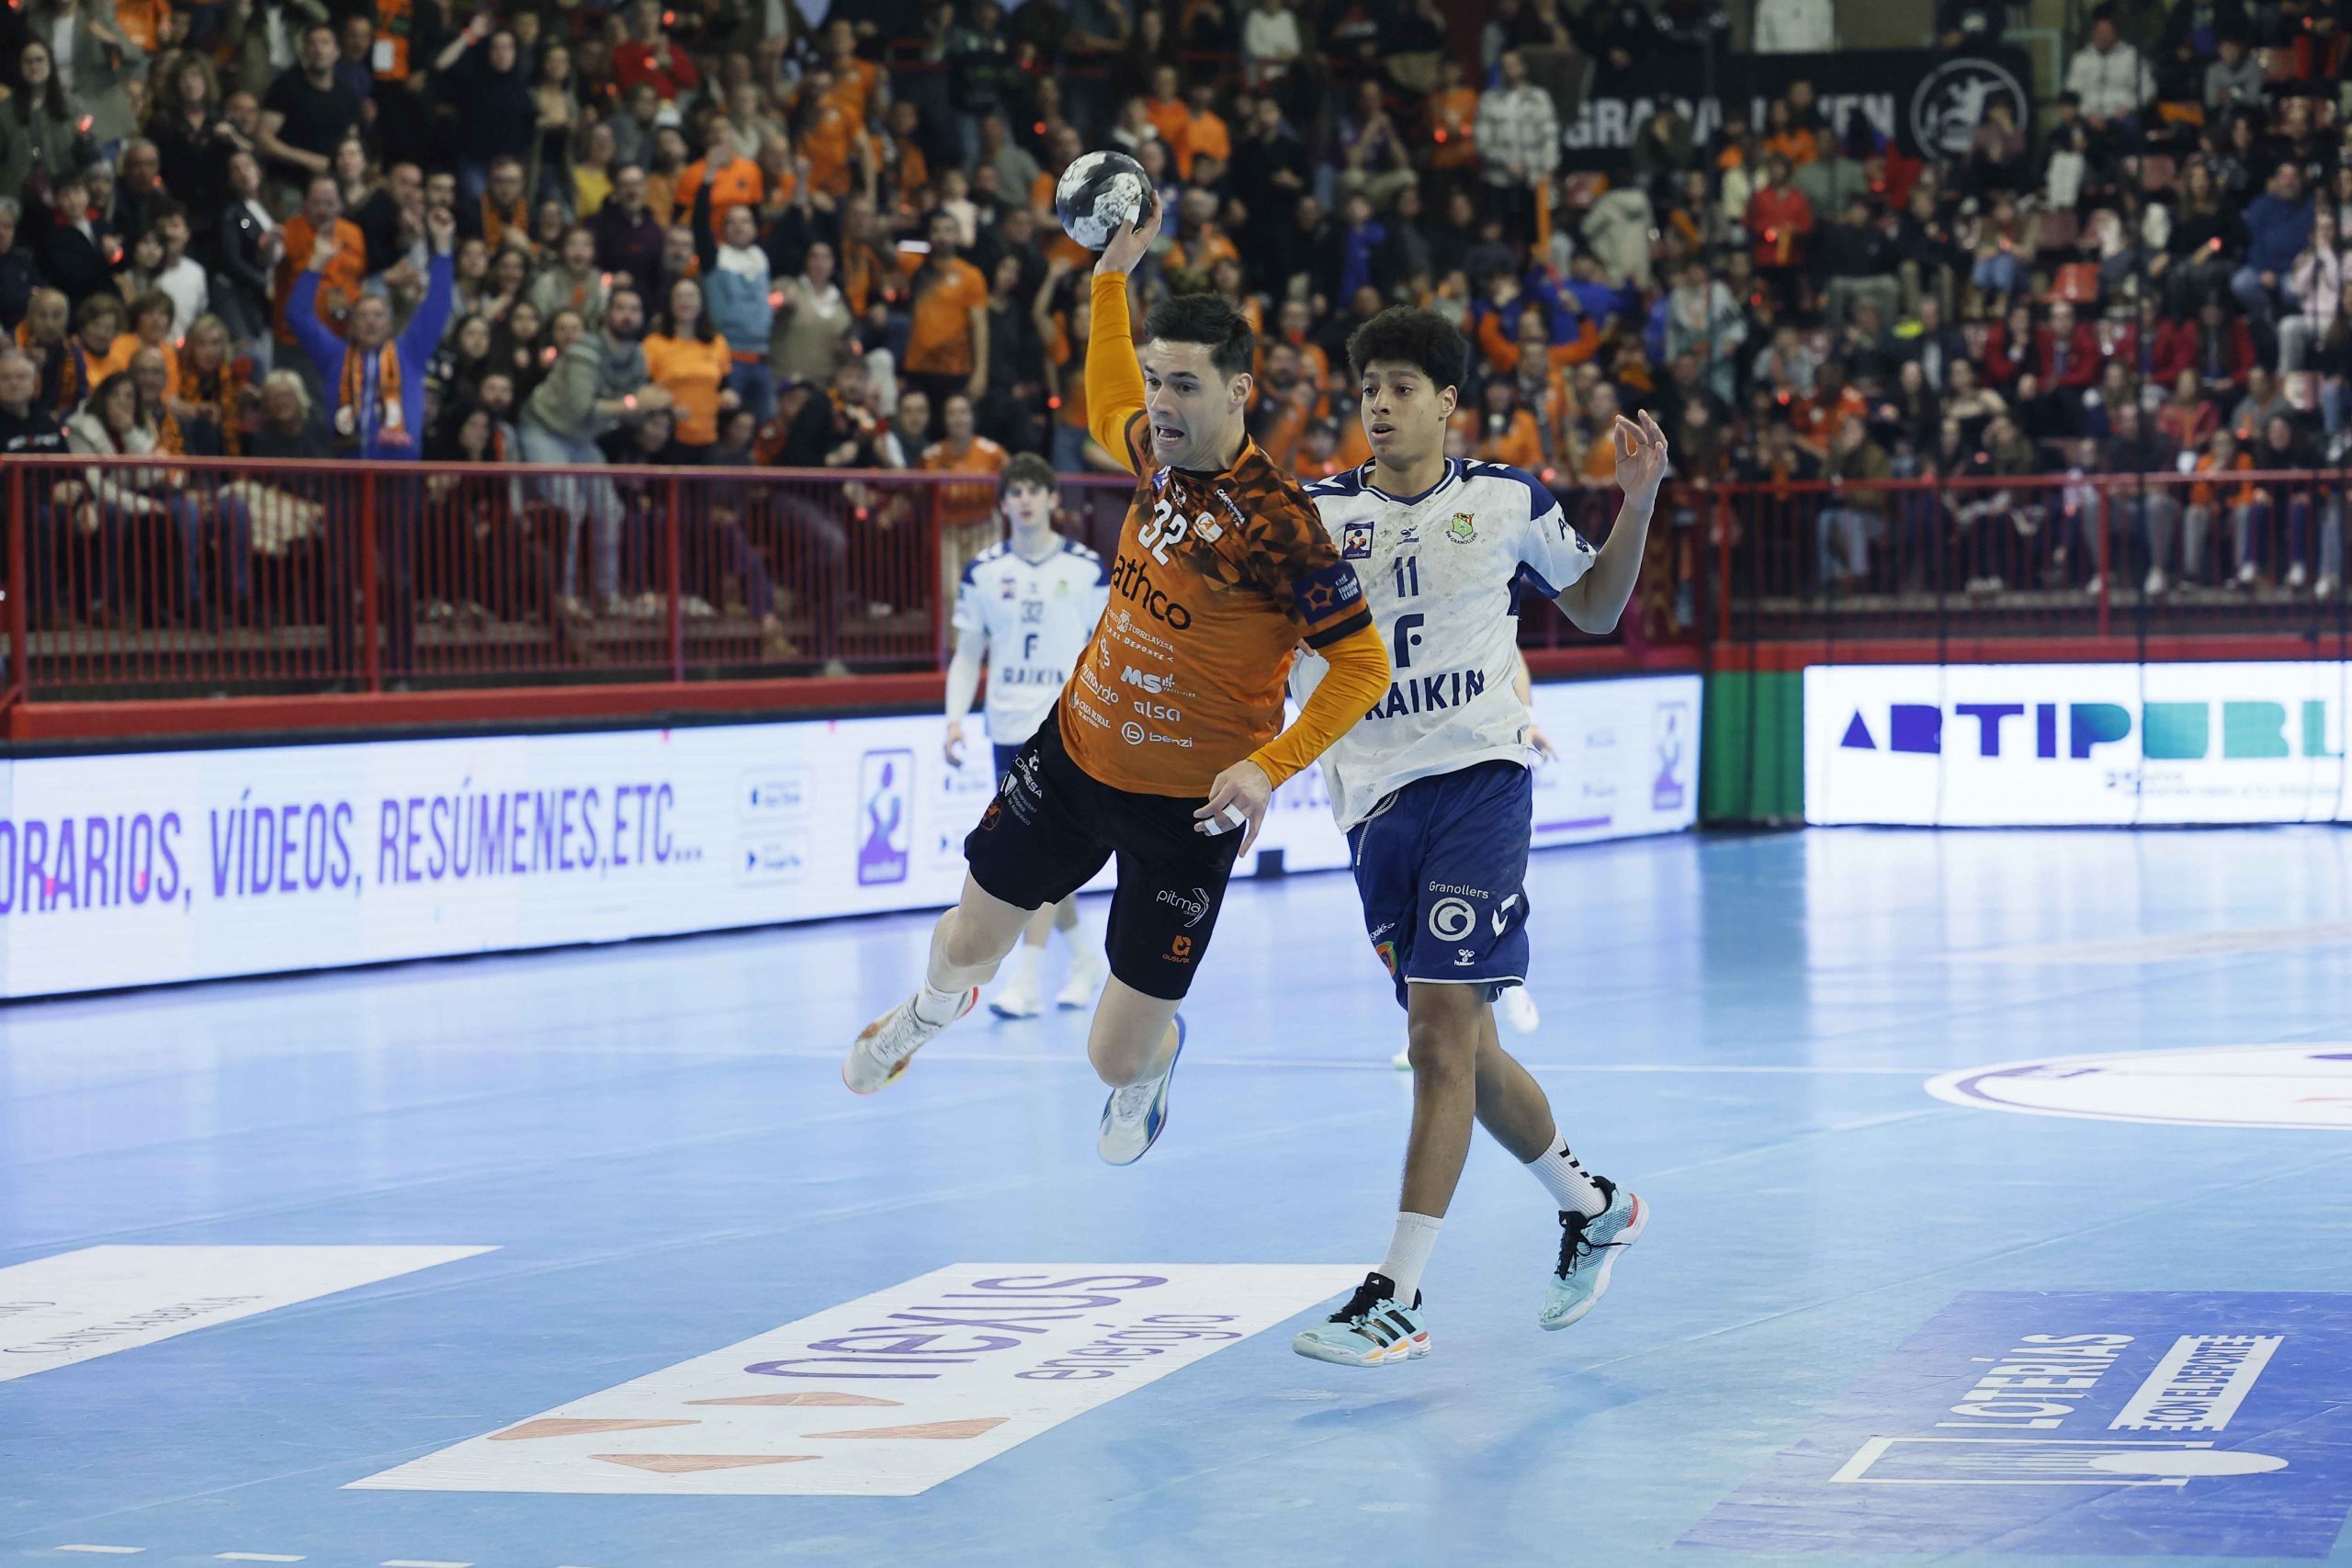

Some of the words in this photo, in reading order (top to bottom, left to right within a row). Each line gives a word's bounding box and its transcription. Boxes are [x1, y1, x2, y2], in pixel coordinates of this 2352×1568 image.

[1564, 96, 1724, 149] GRAA
[1138, 498, 1188, 566] 32
[1394, 556, 1419, 598] 11
[1133, 701, 1181, 722] alsa
[1148, 731, 1193, 748] benzi
[1013, 754, 1043, 799] OPSESA
[210, 787, 363, 900] VÍDEOS,
[1156, 890, 1202, 913] pitma
[1429, 880, 1489, 899] Granollers
[743, 1275, 1169, 1380] nexus
[1934, 1334, 2136, 1429] LOTERÍAS
[2172, 1341, 2256, 1384] DEPORTE
[2143, 1400, 2217, 1423] CON
[2161, 1386, 2225, 1397] EL
